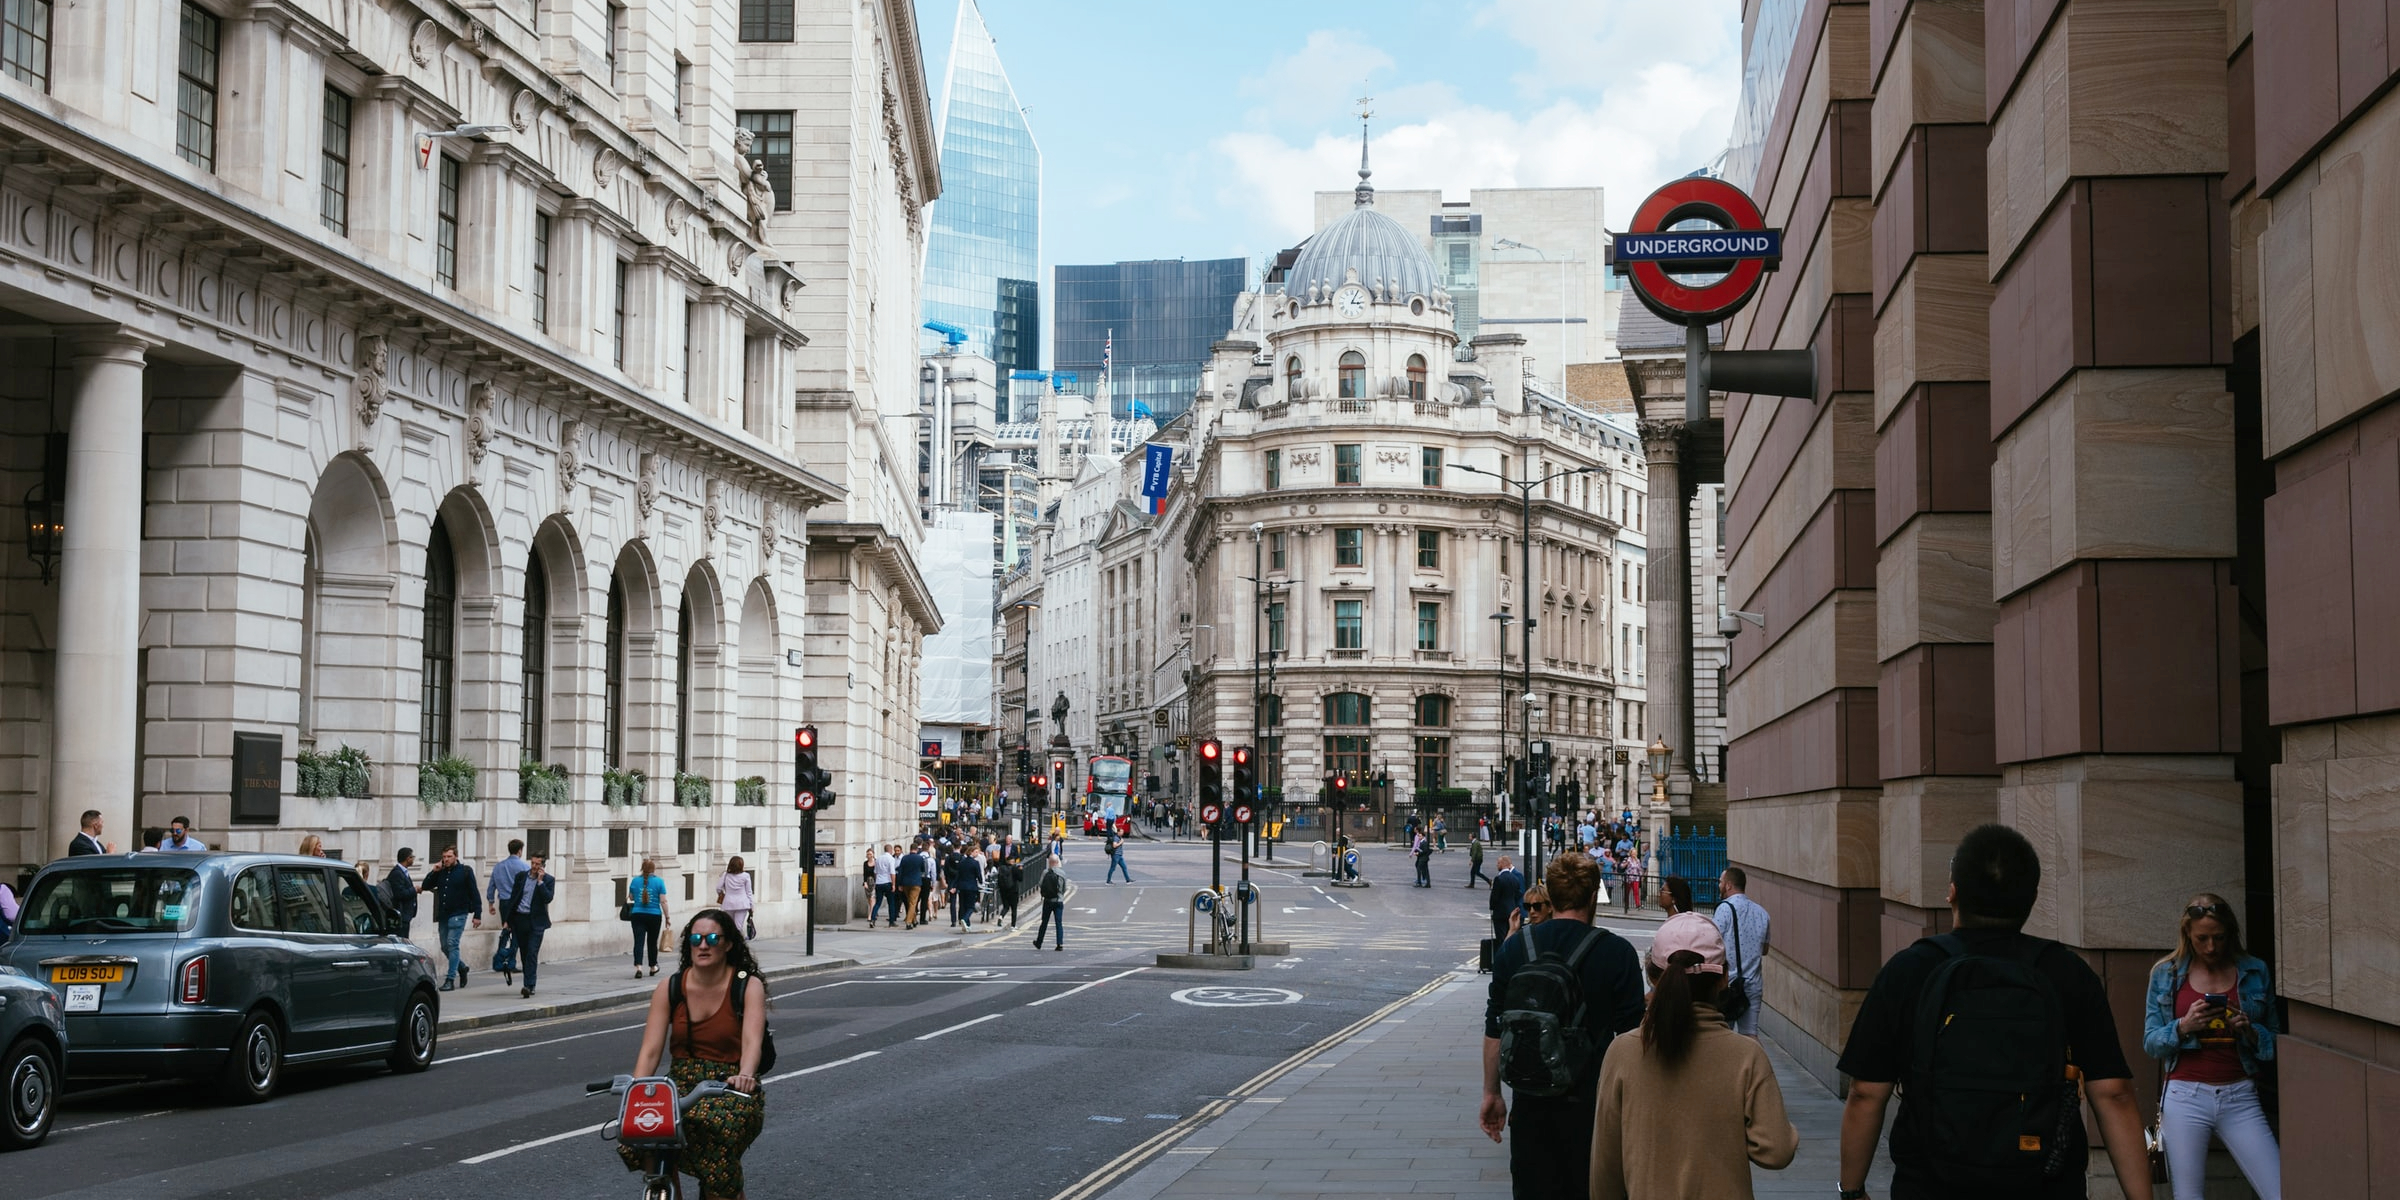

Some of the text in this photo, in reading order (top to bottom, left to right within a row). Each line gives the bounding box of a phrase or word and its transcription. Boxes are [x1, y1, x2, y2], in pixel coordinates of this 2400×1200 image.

[1625, 236, 1769, 255] UNDERGROUND
[1154, 451, 1163, 472] Capital
[1616, 751, 1628, 761] 82
[243, 778, 280, 789] THE NED
[60, 967, 116, 981] LO19 SOJ
